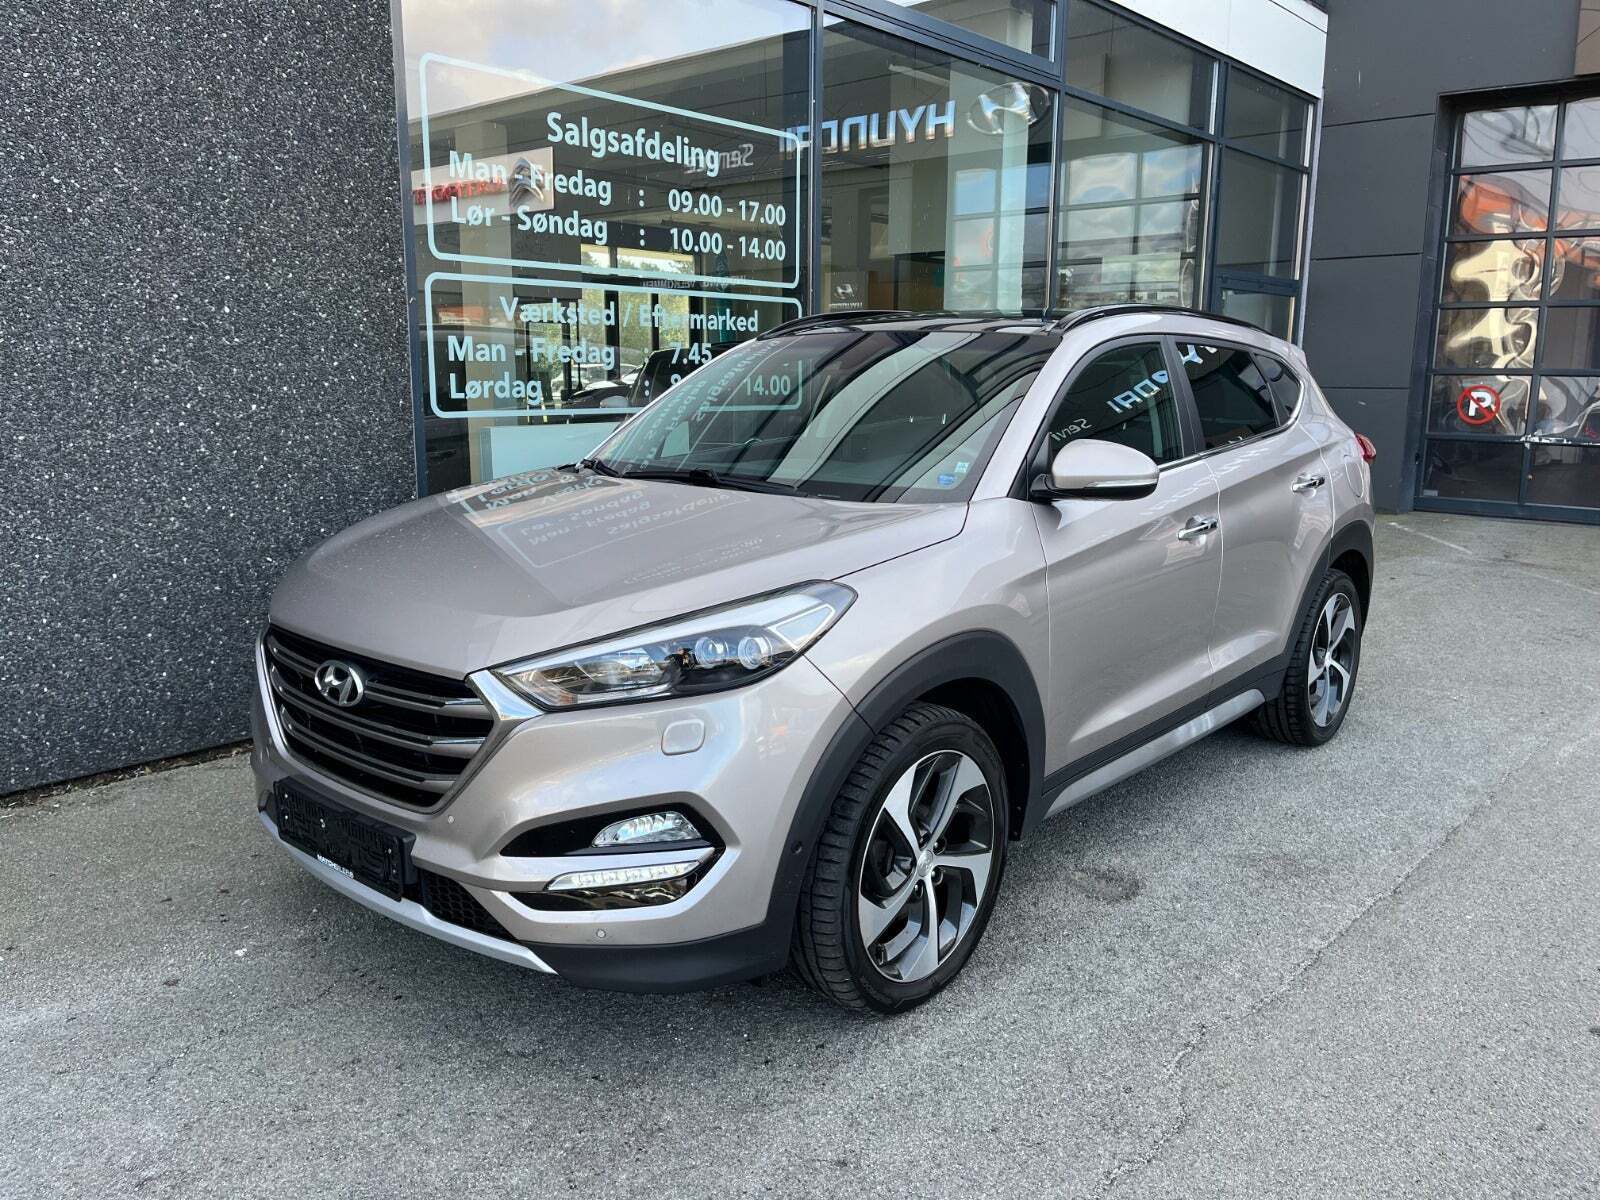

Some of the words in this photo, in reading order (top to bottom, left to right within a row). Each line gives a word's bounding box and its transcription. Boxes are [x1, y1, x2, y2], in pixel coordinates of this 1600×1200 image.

[546, 111, 720, 178] Salgsafdeling
[449, 150, 507, 185] Man
[530, 163, 612, 206] Fredag
[667, 188, 724, 218] 09.00
[738, 200, 787, 227] 17.00
[451, 196, 496, 226] Lør
[516, 205, 608, 245] Søndag
[669, 226, 723, 255] 10.00
[738, 236, 787, 262] 14.00
[500, 296, 616, 326] Værksted
[639, 301, 759, 332] Eftermarked
[447, 335, 506, 362] Man
[532, 337, 615, 370] Fredag
[448, 371, 542, 404] Lørdag
